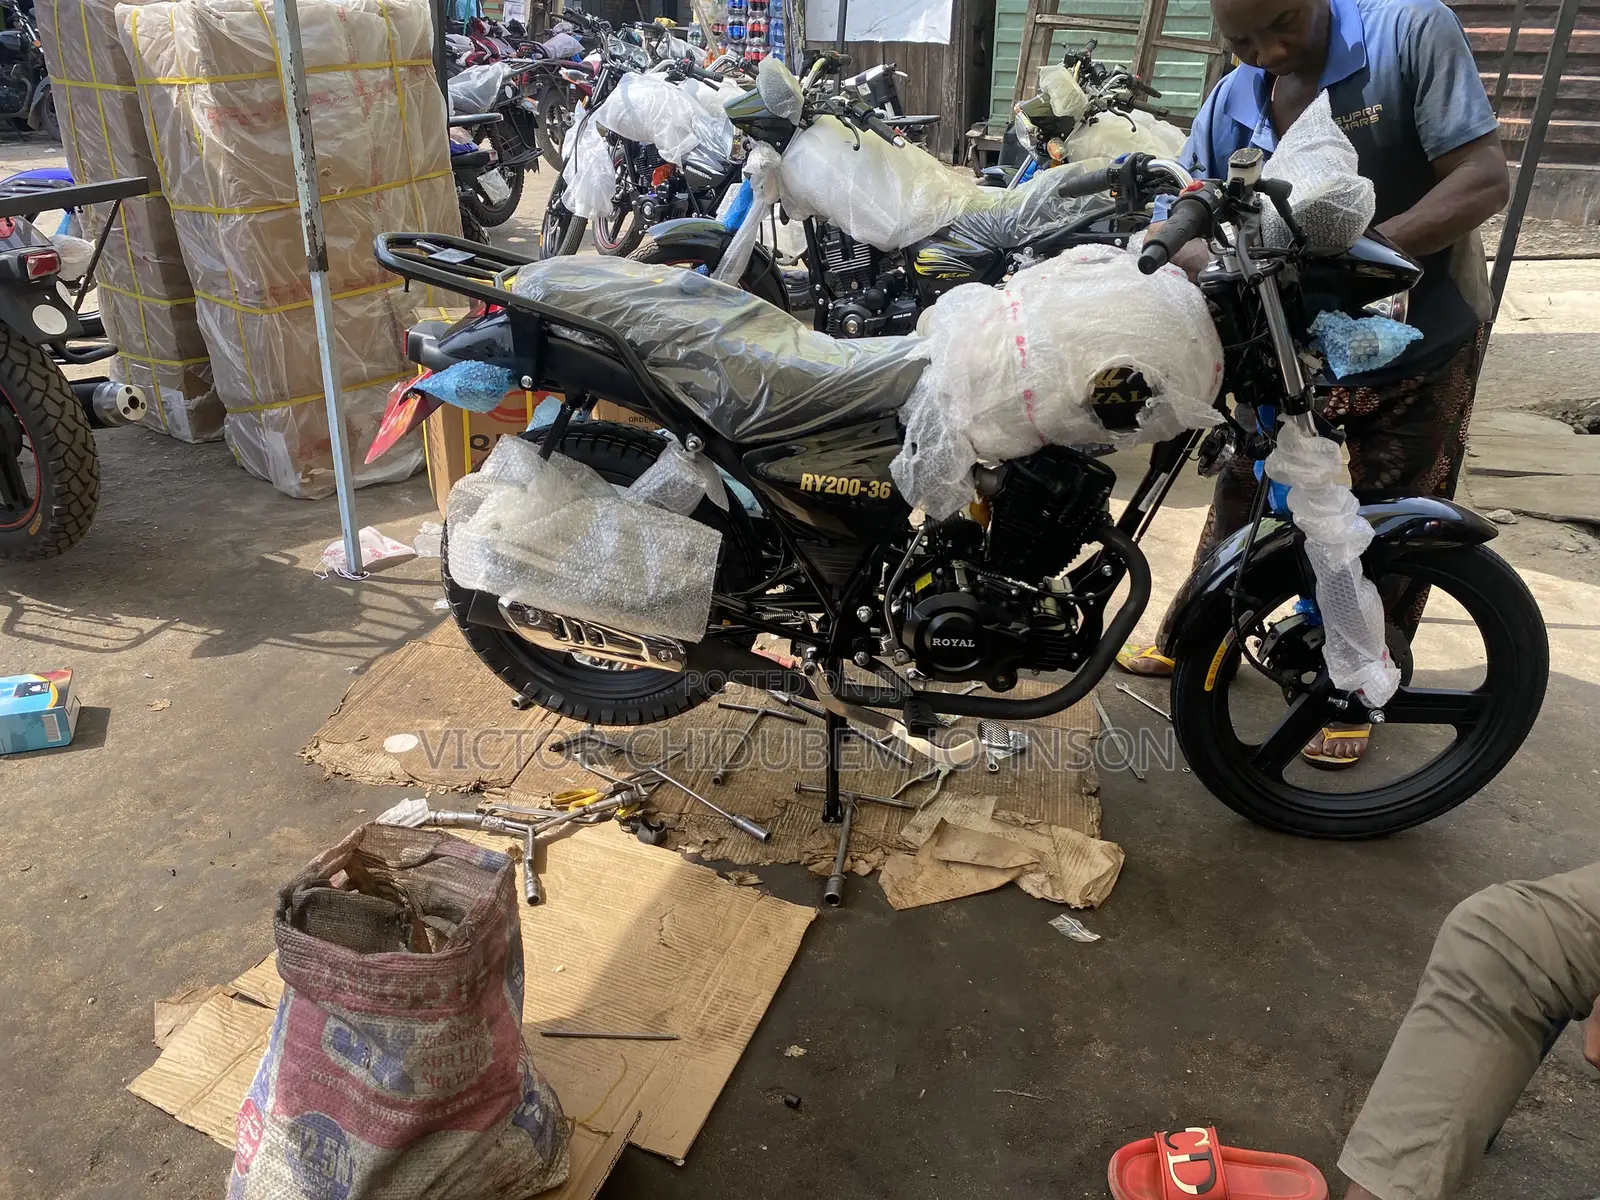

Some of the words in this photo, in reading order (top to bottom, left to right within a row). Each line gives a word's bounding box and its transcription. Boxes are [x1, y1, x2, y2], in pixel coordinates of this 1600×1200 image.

[1335, 104, 1383, 125] SUPRA
[1340, 113, 1380, 132] MARS
[800, 472, 892, 499] RY200-36
[932, 637, 976, 648] ROYAL
